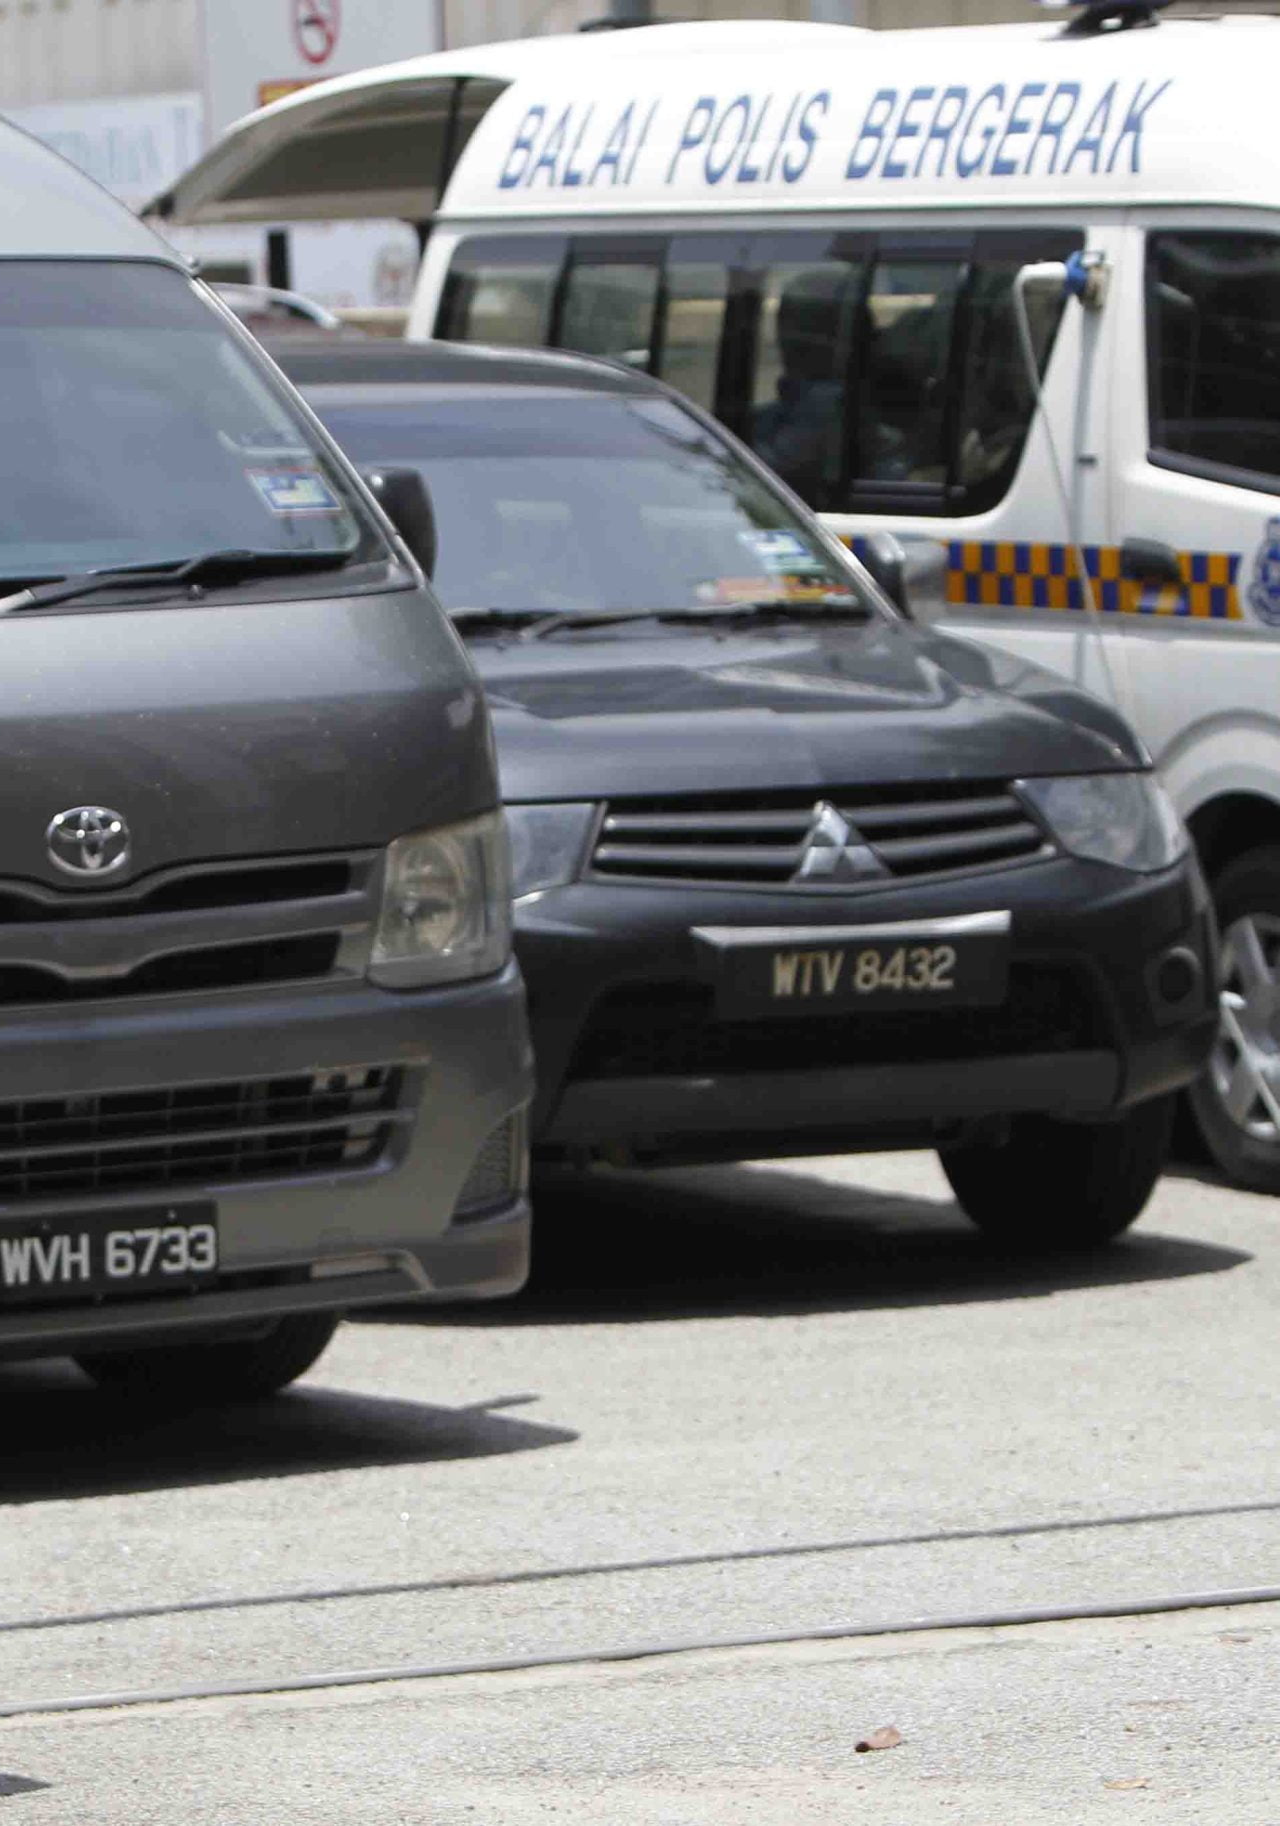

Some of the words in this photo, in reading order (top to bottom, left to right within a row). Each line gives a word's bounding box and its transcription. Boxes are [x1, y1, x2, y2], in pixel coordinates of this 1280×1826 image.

[499, 102, 659, 189] BALAI
[667, 92, 829, 183] POLIS
[846, 80, 1171, 179] BERGERAK
[773, 950, 844, 996] WTV
[855, 945, 956, 991] 8432
[0, 1233, 90, 1285] WVH
[105, 1225, 217, 1277] 6733
